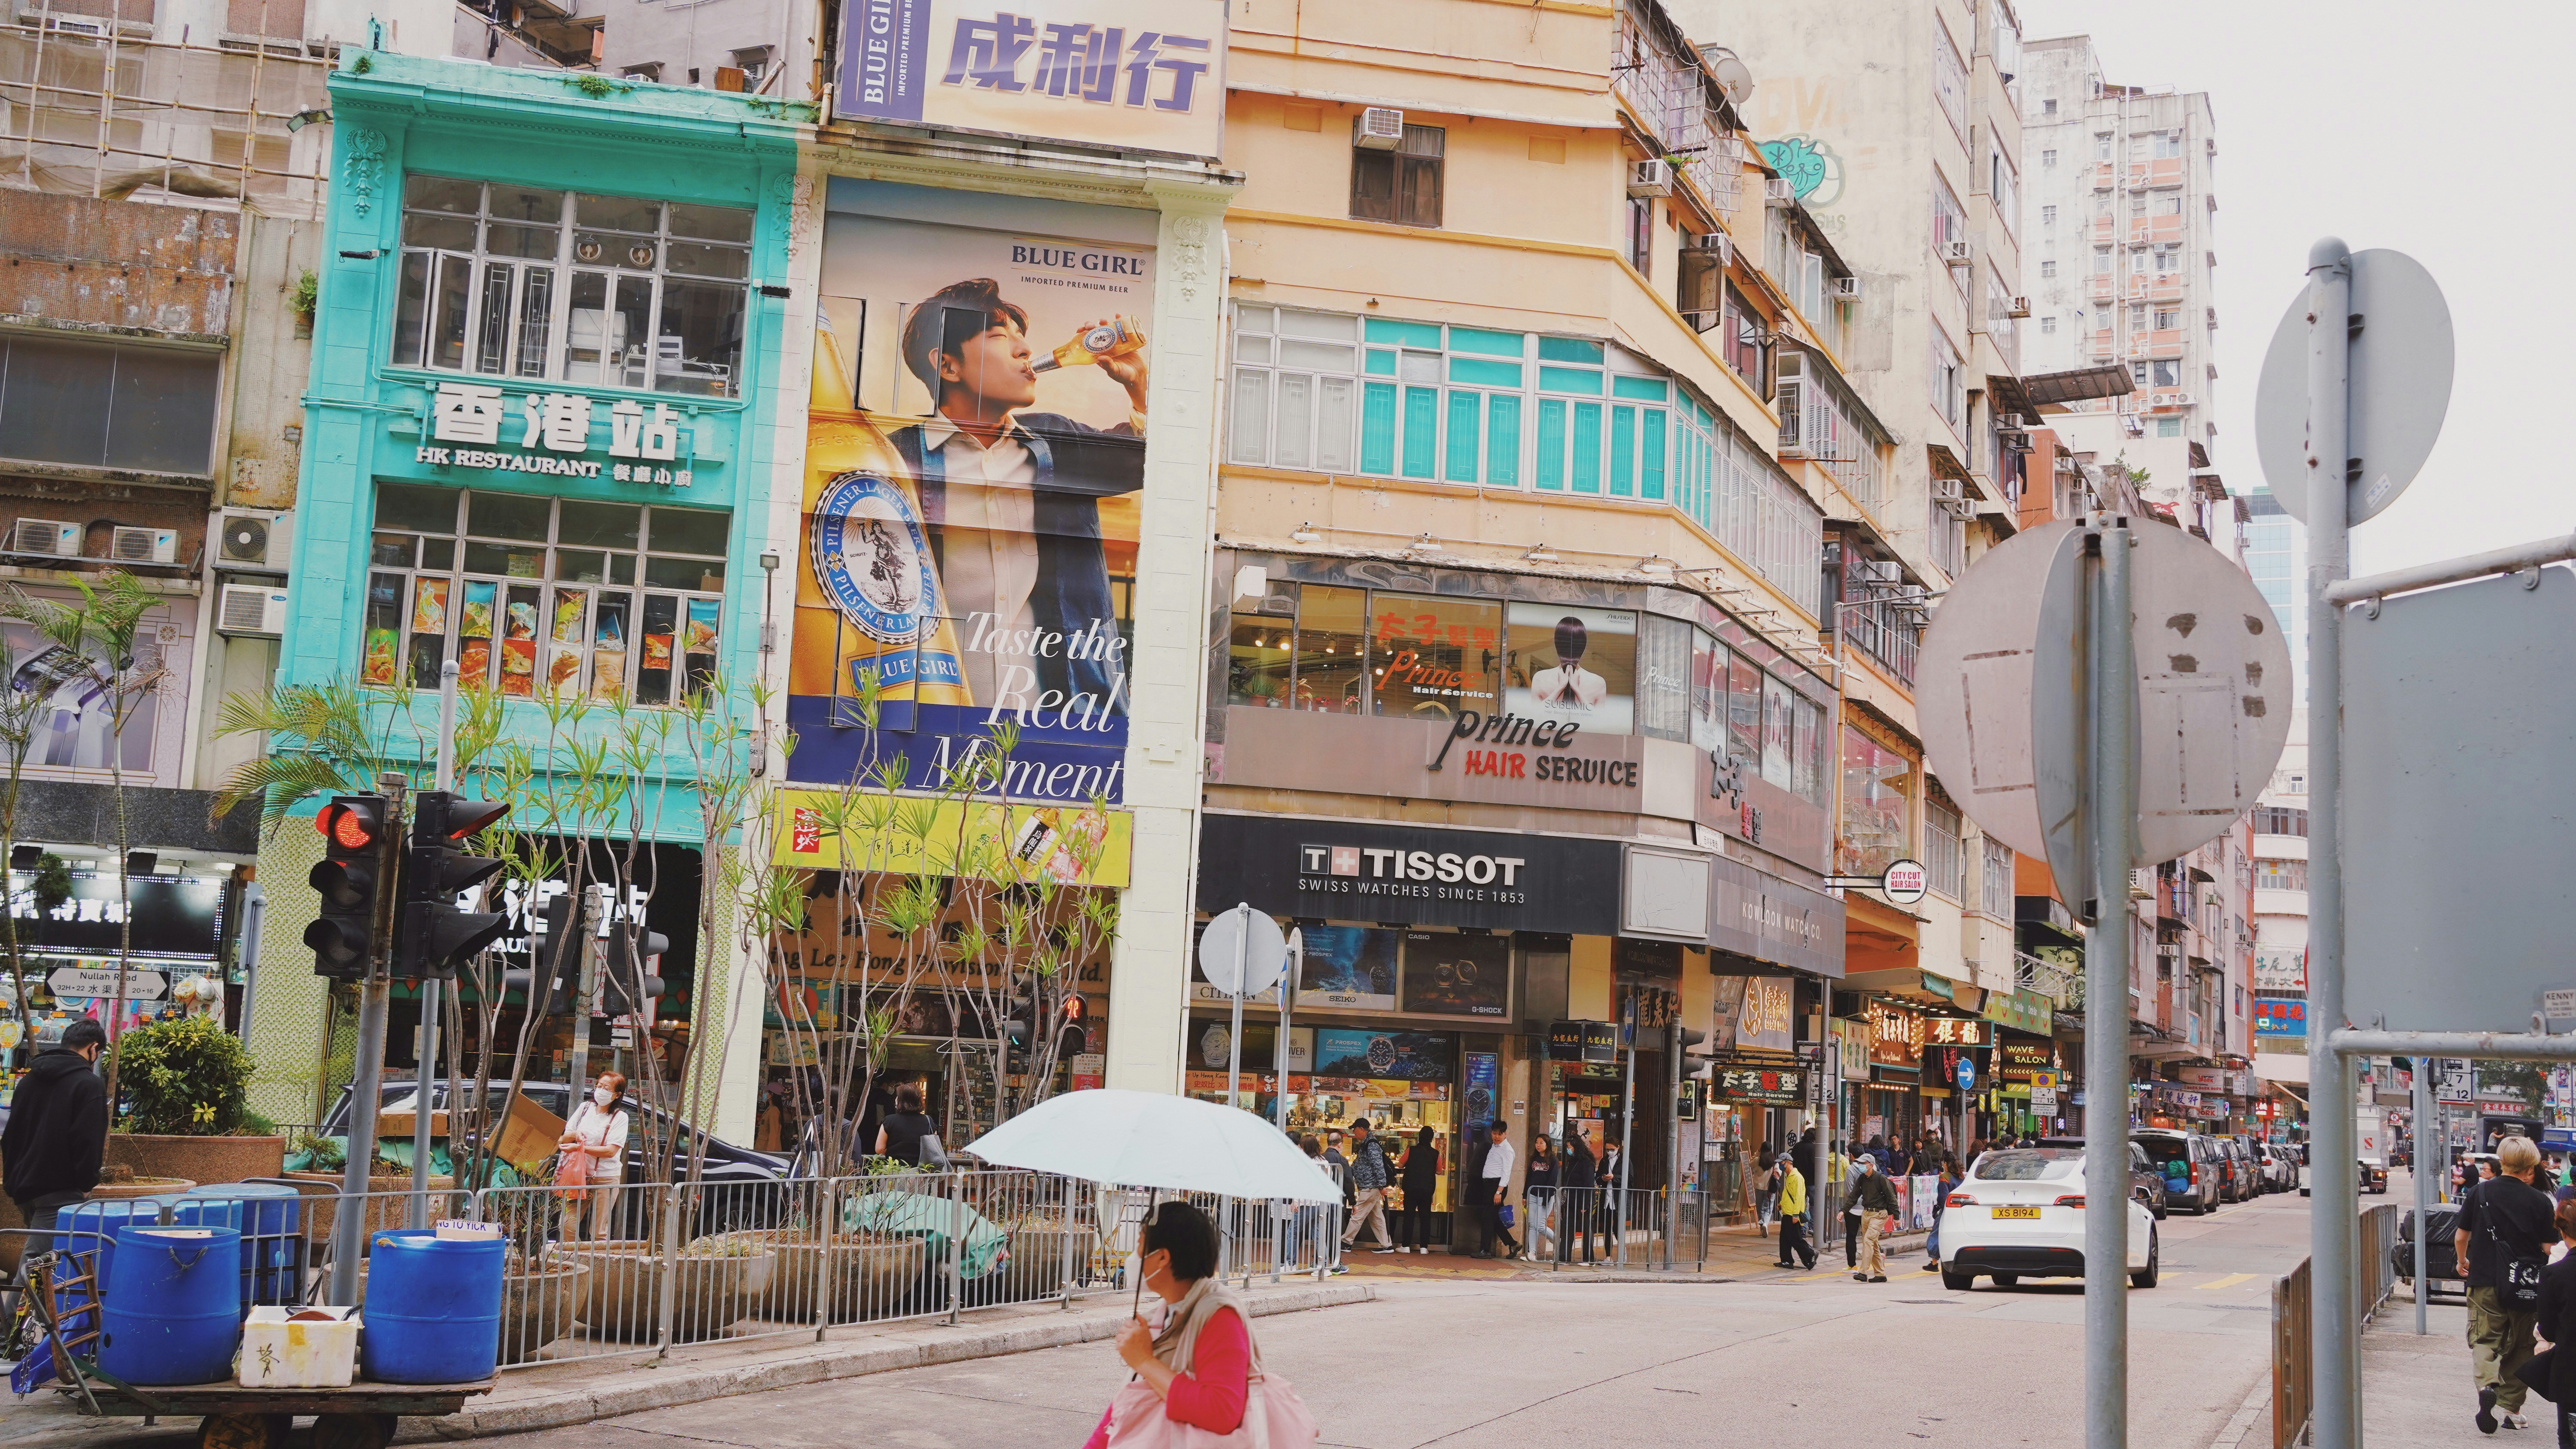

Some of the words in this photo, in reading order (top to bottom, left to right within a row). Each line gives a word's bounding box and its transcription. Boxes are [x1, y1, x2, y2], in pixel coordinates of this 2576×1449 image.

[870, 0, 891, 34] GI
[902, 11, 912, 50] PREMIUM
[864, 39, 888, 104] BLUE
[898, 53, 908, 96] IMPORTED
[941, 12, 1212, 114] 成利行
[1012, 246, 1075, 269] BLUE
[1081, 253, 1143, 276] GIRL
[1021, 276, 1063, 286] IMPORTED
[1067, 281, 1106, 291] PREMIUM
[433, 382, 680, 461] 香港站
[416, 446, 450, 465] HK
[453, 449, 601, 479] RESTAURANT
[612, 463, 693, 487] 餐廳小廚
[827, 485, 863, 546] PILSENER
[864, 482, 904, 512] LAGER
[835, 575, 895, 630] PILSENER
[899, 603, 931, 629] LAGER
[923, 572, 934, 603] BIER
[964, 611, 1061, 658] Taste
[1066, 618, 1128, 663] the
[913, 658, 957, 677] GIRL
[1374, 650, 1483, 690] Prince
[1643, 666, 1680, 687] Prince
[979, 664, 1126, 733] Real
[1413, 686, 1440, 695] Hair
[1445, 688, 1494, 699] Service
[1545, 700, 1593, 711] SUBLIMIC
[1427, 710, 1580, 771] Prince
[916, 735, 1125, 800] Moment
[1465, 750, 1526, 779] HAIR
[1535, 755, 1638, 788] SERVICE
[1364, 848, 1525, 886] TISSOT
[1891, 871, 1905, 880] CITY
[1908, 871, 1921, 880] CUT
[1298, 878, 1349, 892] SWISS
[1358, 882, 1429, 898] WATCHES
[1438, 887, 1483, 901] SINCE
[1492, 891, 1525, 904] 1853
[1891, 881, 1903, 889] HAIR
[1904, 881, 1921, 889] SALON
[1743, 902, 1781, 928] KOWLOON
[1785, 915, 1808, 936] WATCH
[1811, 924, 1822, 941] CO.
[80, 972, 110, 980] Nullah
[113, 973, 137, 982] Rad
[1471, 1006, 1503, 1014] G-SHOCK
[1934, 1020, 1980, 1044] 銀龍
[2006, 1046, 2035, 1054] WAVE
[2014, 1055, 2046, 1064] SALON
[1722, 1070, 1798, 1091] 太子髮型
[2456, 1075, 2463, 1083] 7
[2456, 1090, 2469, 1099] 12
[1998, 1209, 2010, 1217] XS
[2013, 1209, 2034, 1217] 8194
[466, 1222, 486, 1231] YICK
